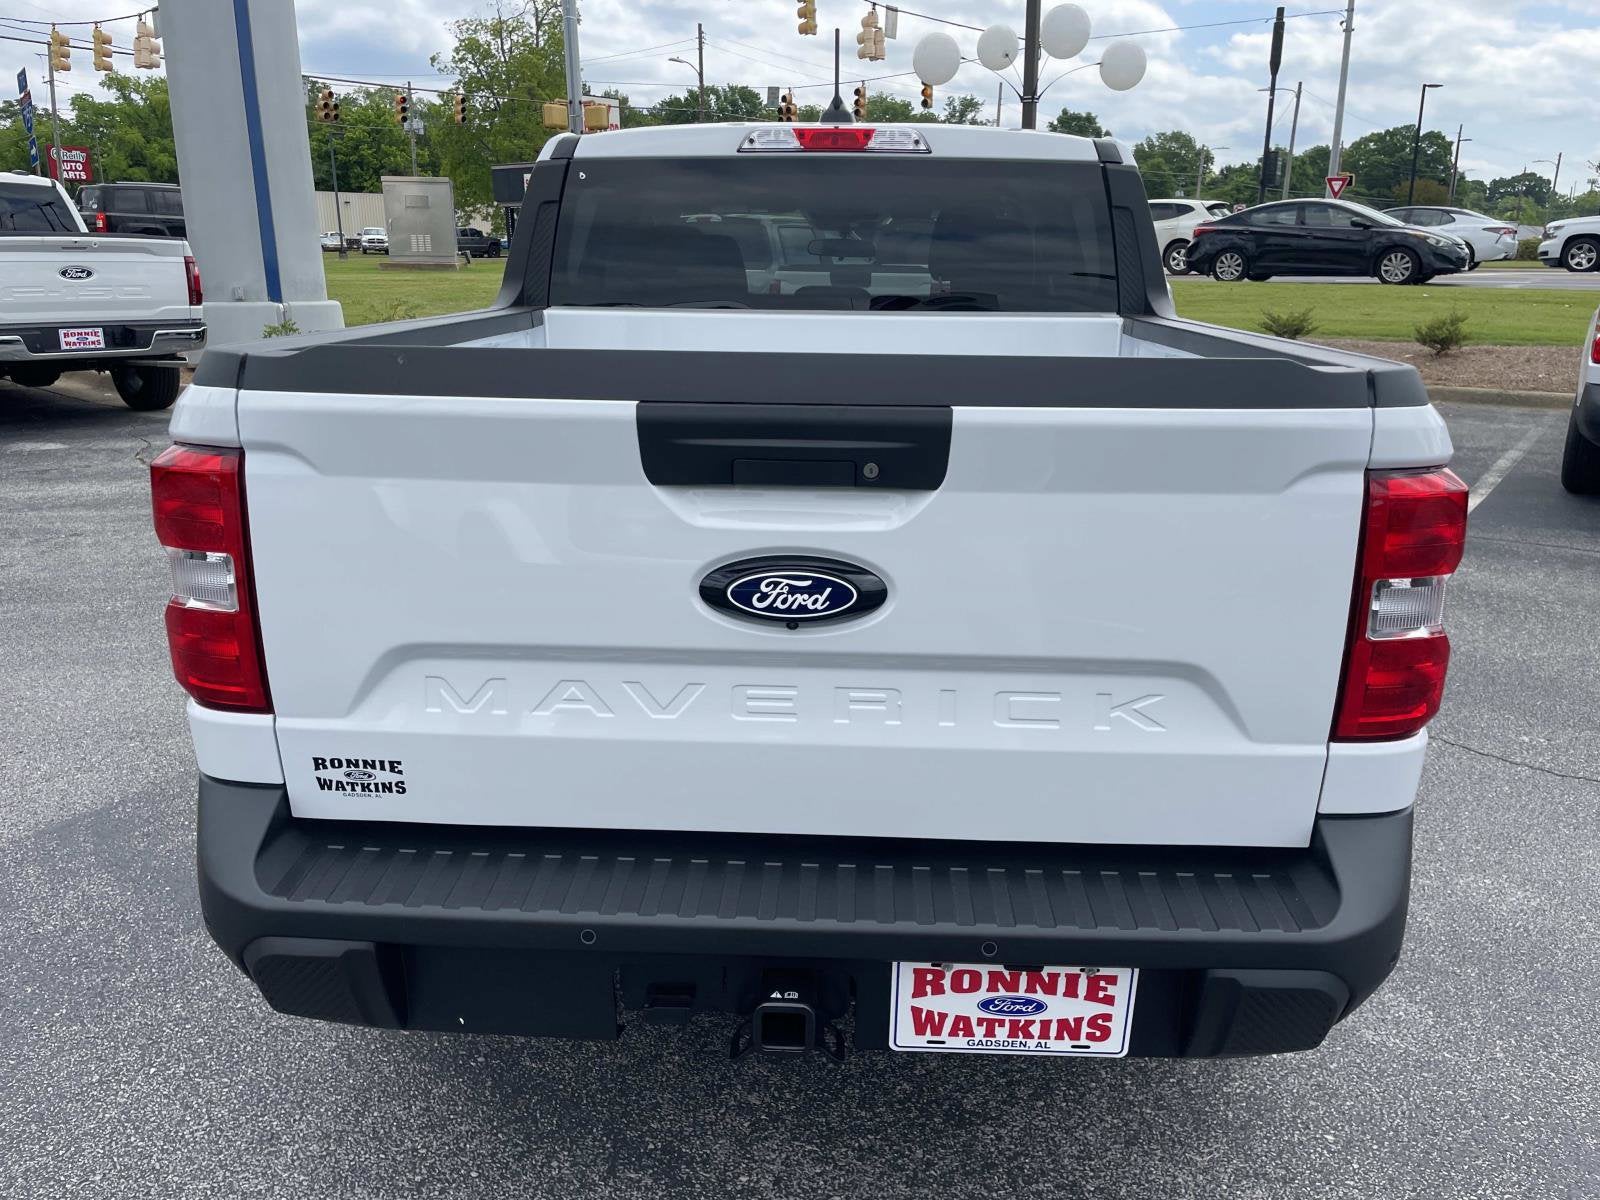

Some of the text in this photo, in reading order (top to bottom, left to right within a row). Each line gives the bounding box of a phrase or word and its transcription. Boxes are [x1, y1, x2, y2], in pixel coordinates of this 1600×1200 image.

[63, 171, 87, 179] ARTS
[66, 268, 88, 278] Ford
[752, 577, 833, 610] Ford
[425, 676, 1167, 732] MAVERICK
[312, 757, 404, 775] RONNIE
[315, 776, 407, 794] WATKINS
[911, 968, 1119, 1007] RONNIE
[988, 998, 1037, 1013] Ford
[910, 1005, 1114, 1043] WATKINS
[966, 1038, 1051, 1050] GADSDEN, AL
